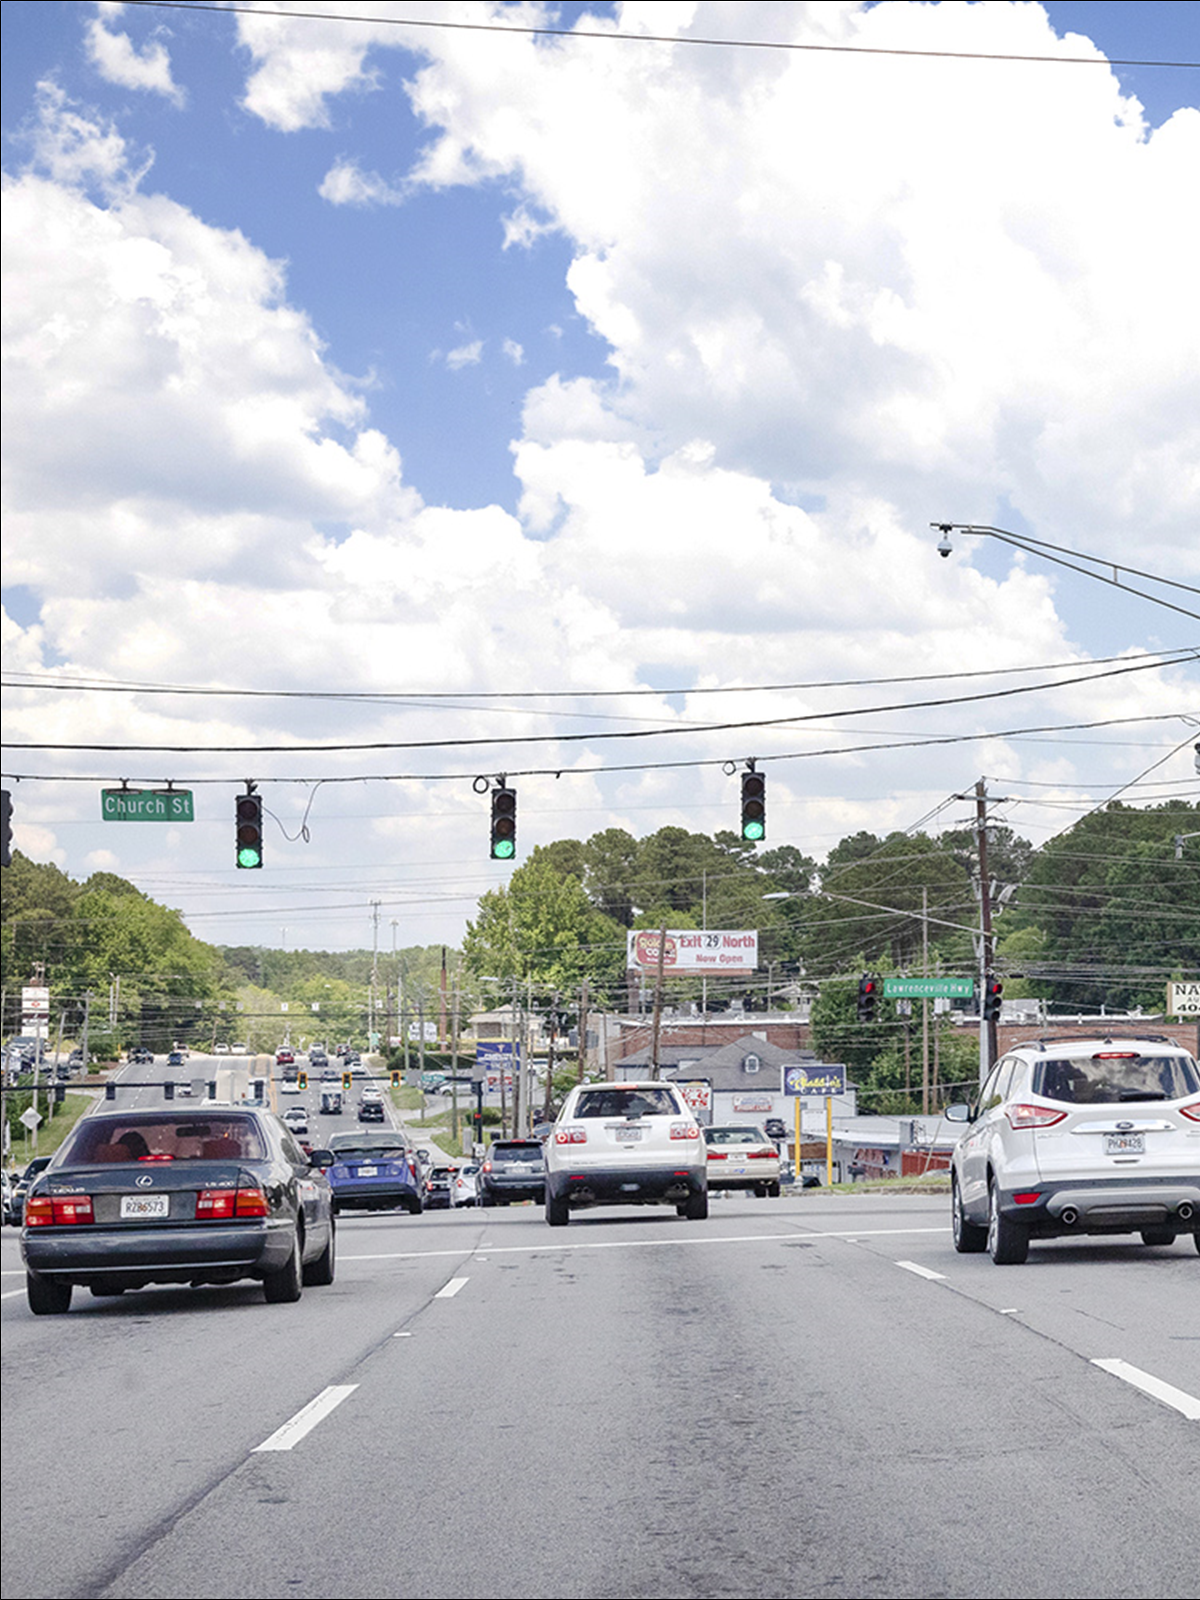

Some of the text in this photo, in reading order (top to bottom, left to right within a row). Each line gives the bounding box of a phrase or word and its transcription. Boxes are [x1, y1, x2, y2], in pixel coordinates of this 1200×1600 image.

[105, 797, 190, 814] Church St
[681, 935, 755, 948] Exit 29 North
[696, 953, 743, 964] Now Open
[886, 983, 970, 995] Lawrenceville Hwy
